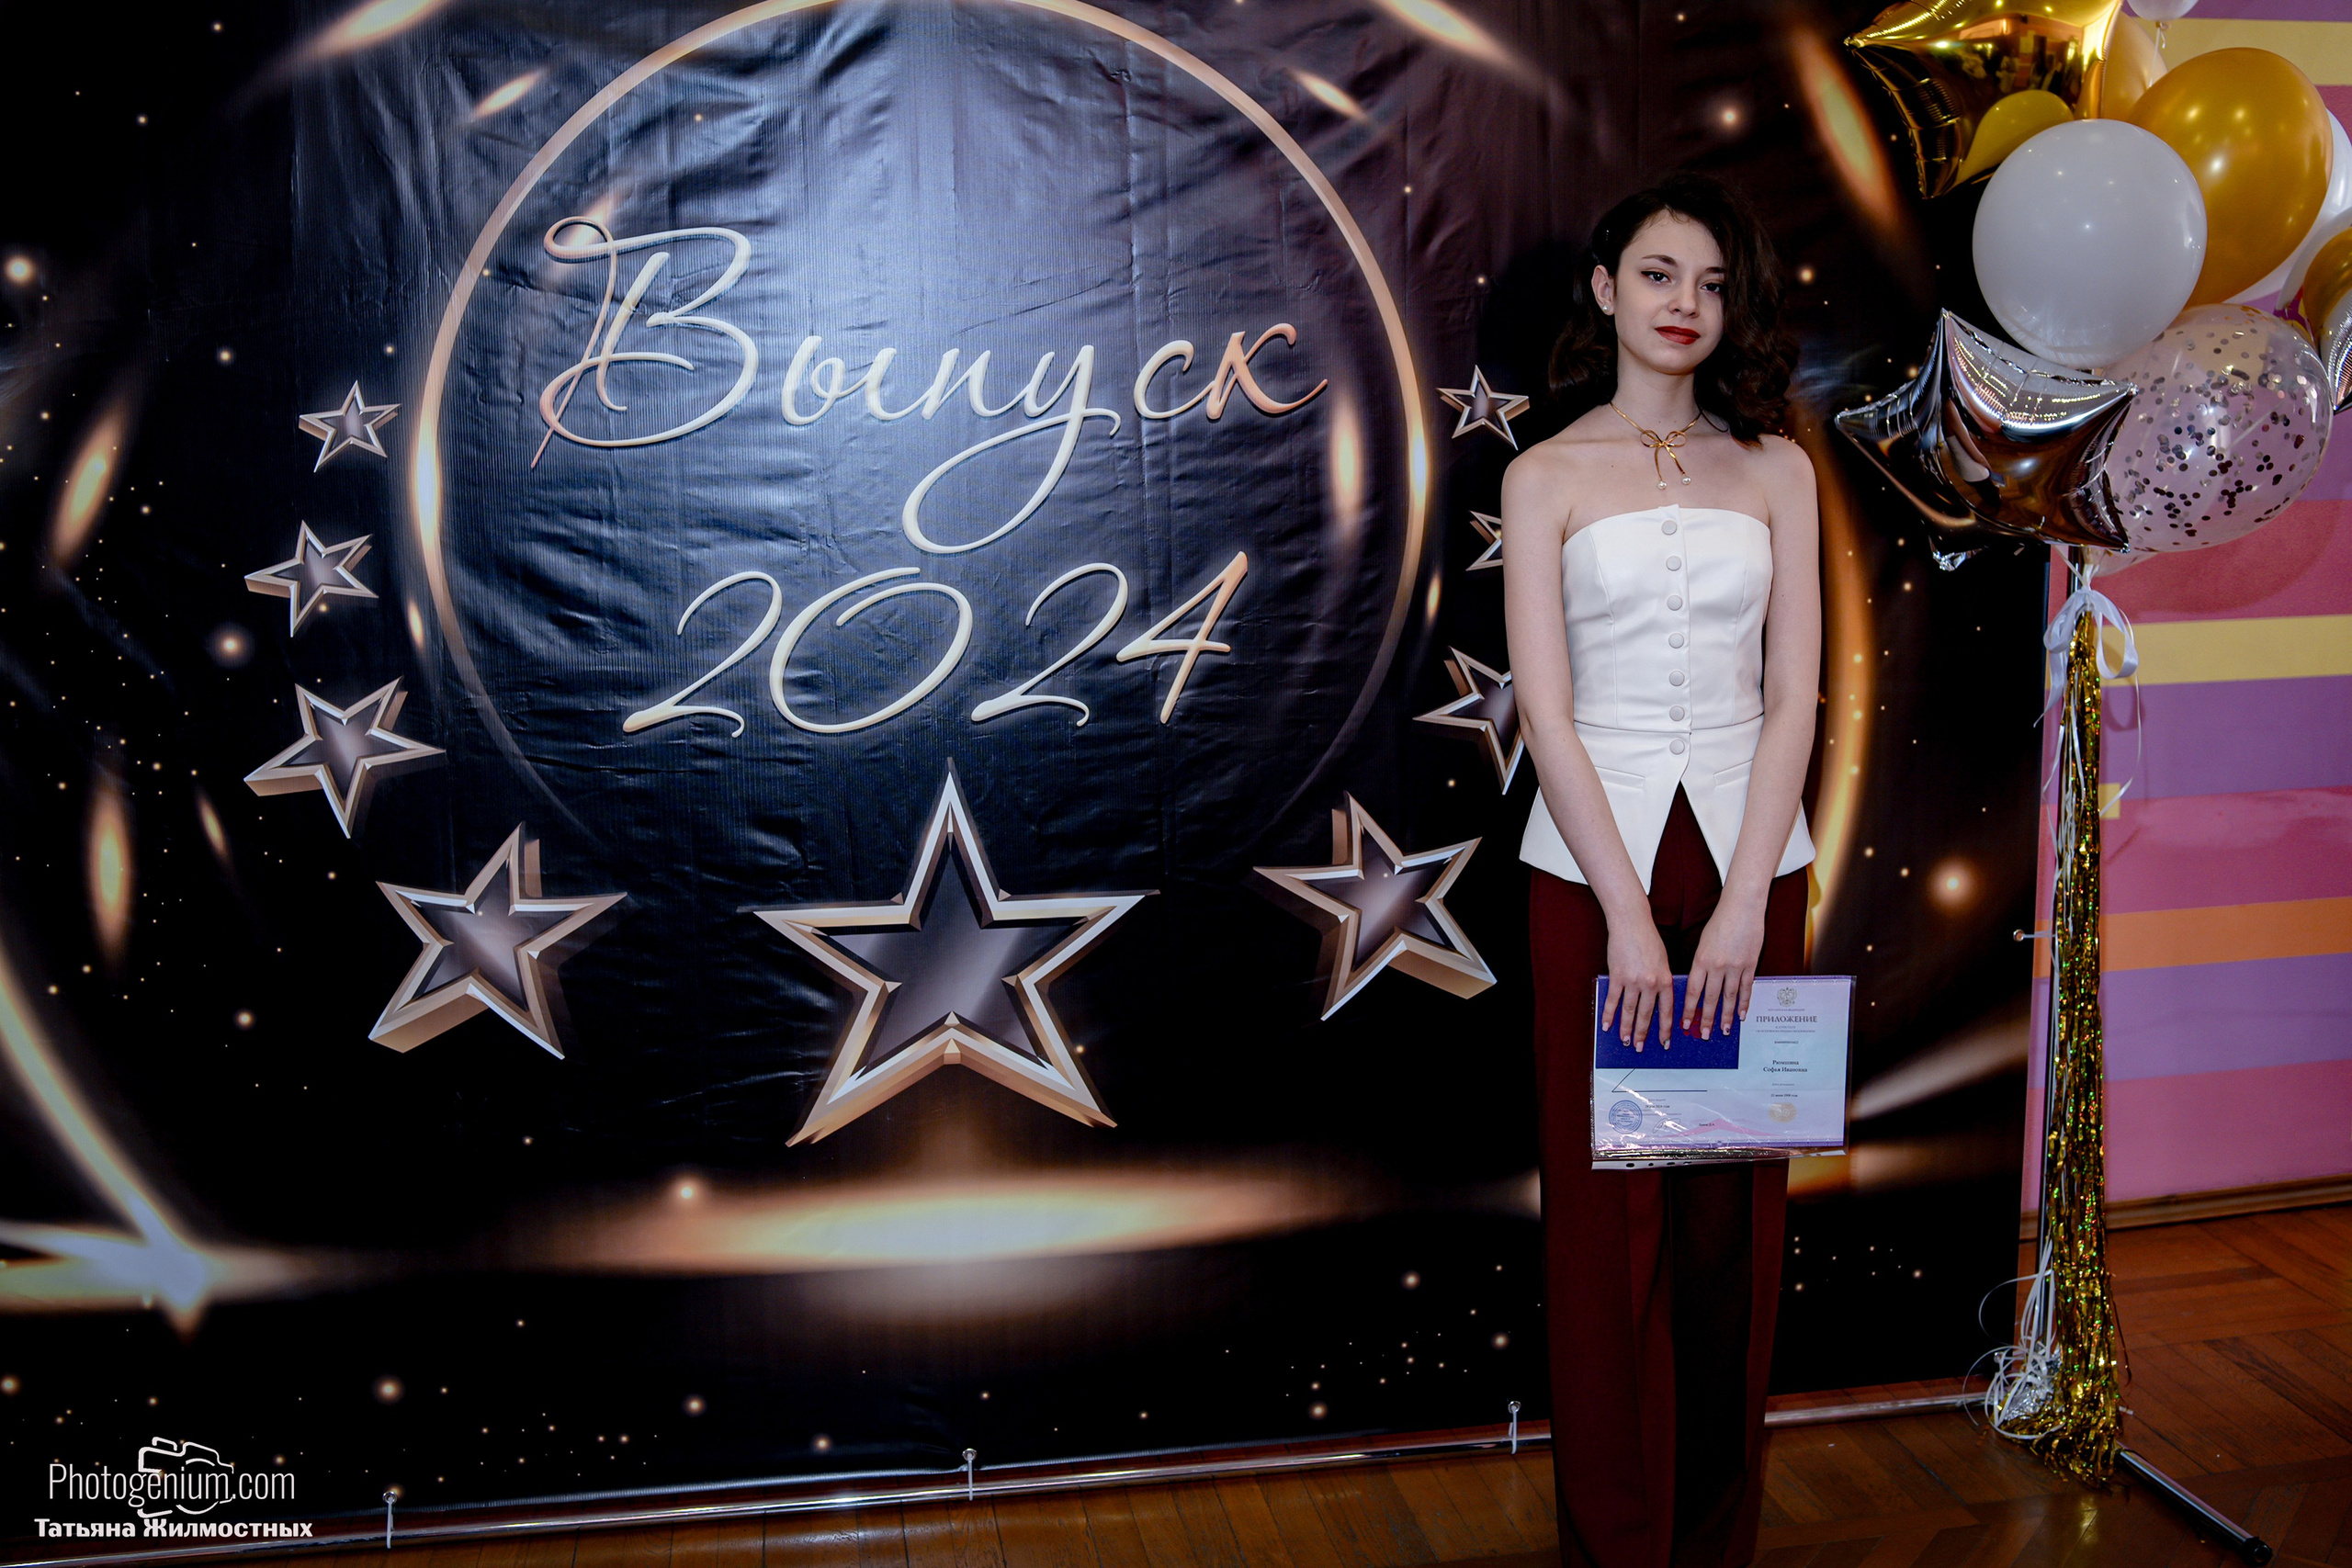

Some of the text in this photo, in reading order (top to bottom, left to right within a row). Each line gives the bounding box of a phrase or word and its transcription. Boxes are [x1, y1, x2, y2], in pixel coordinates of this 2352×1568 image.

[531, 216, 1329, 555] Выпуск
[622, 552, 1249, 738] 2024
[1756, 1015, 1818, 1023] ПРИЛОЖЕНИЕ
